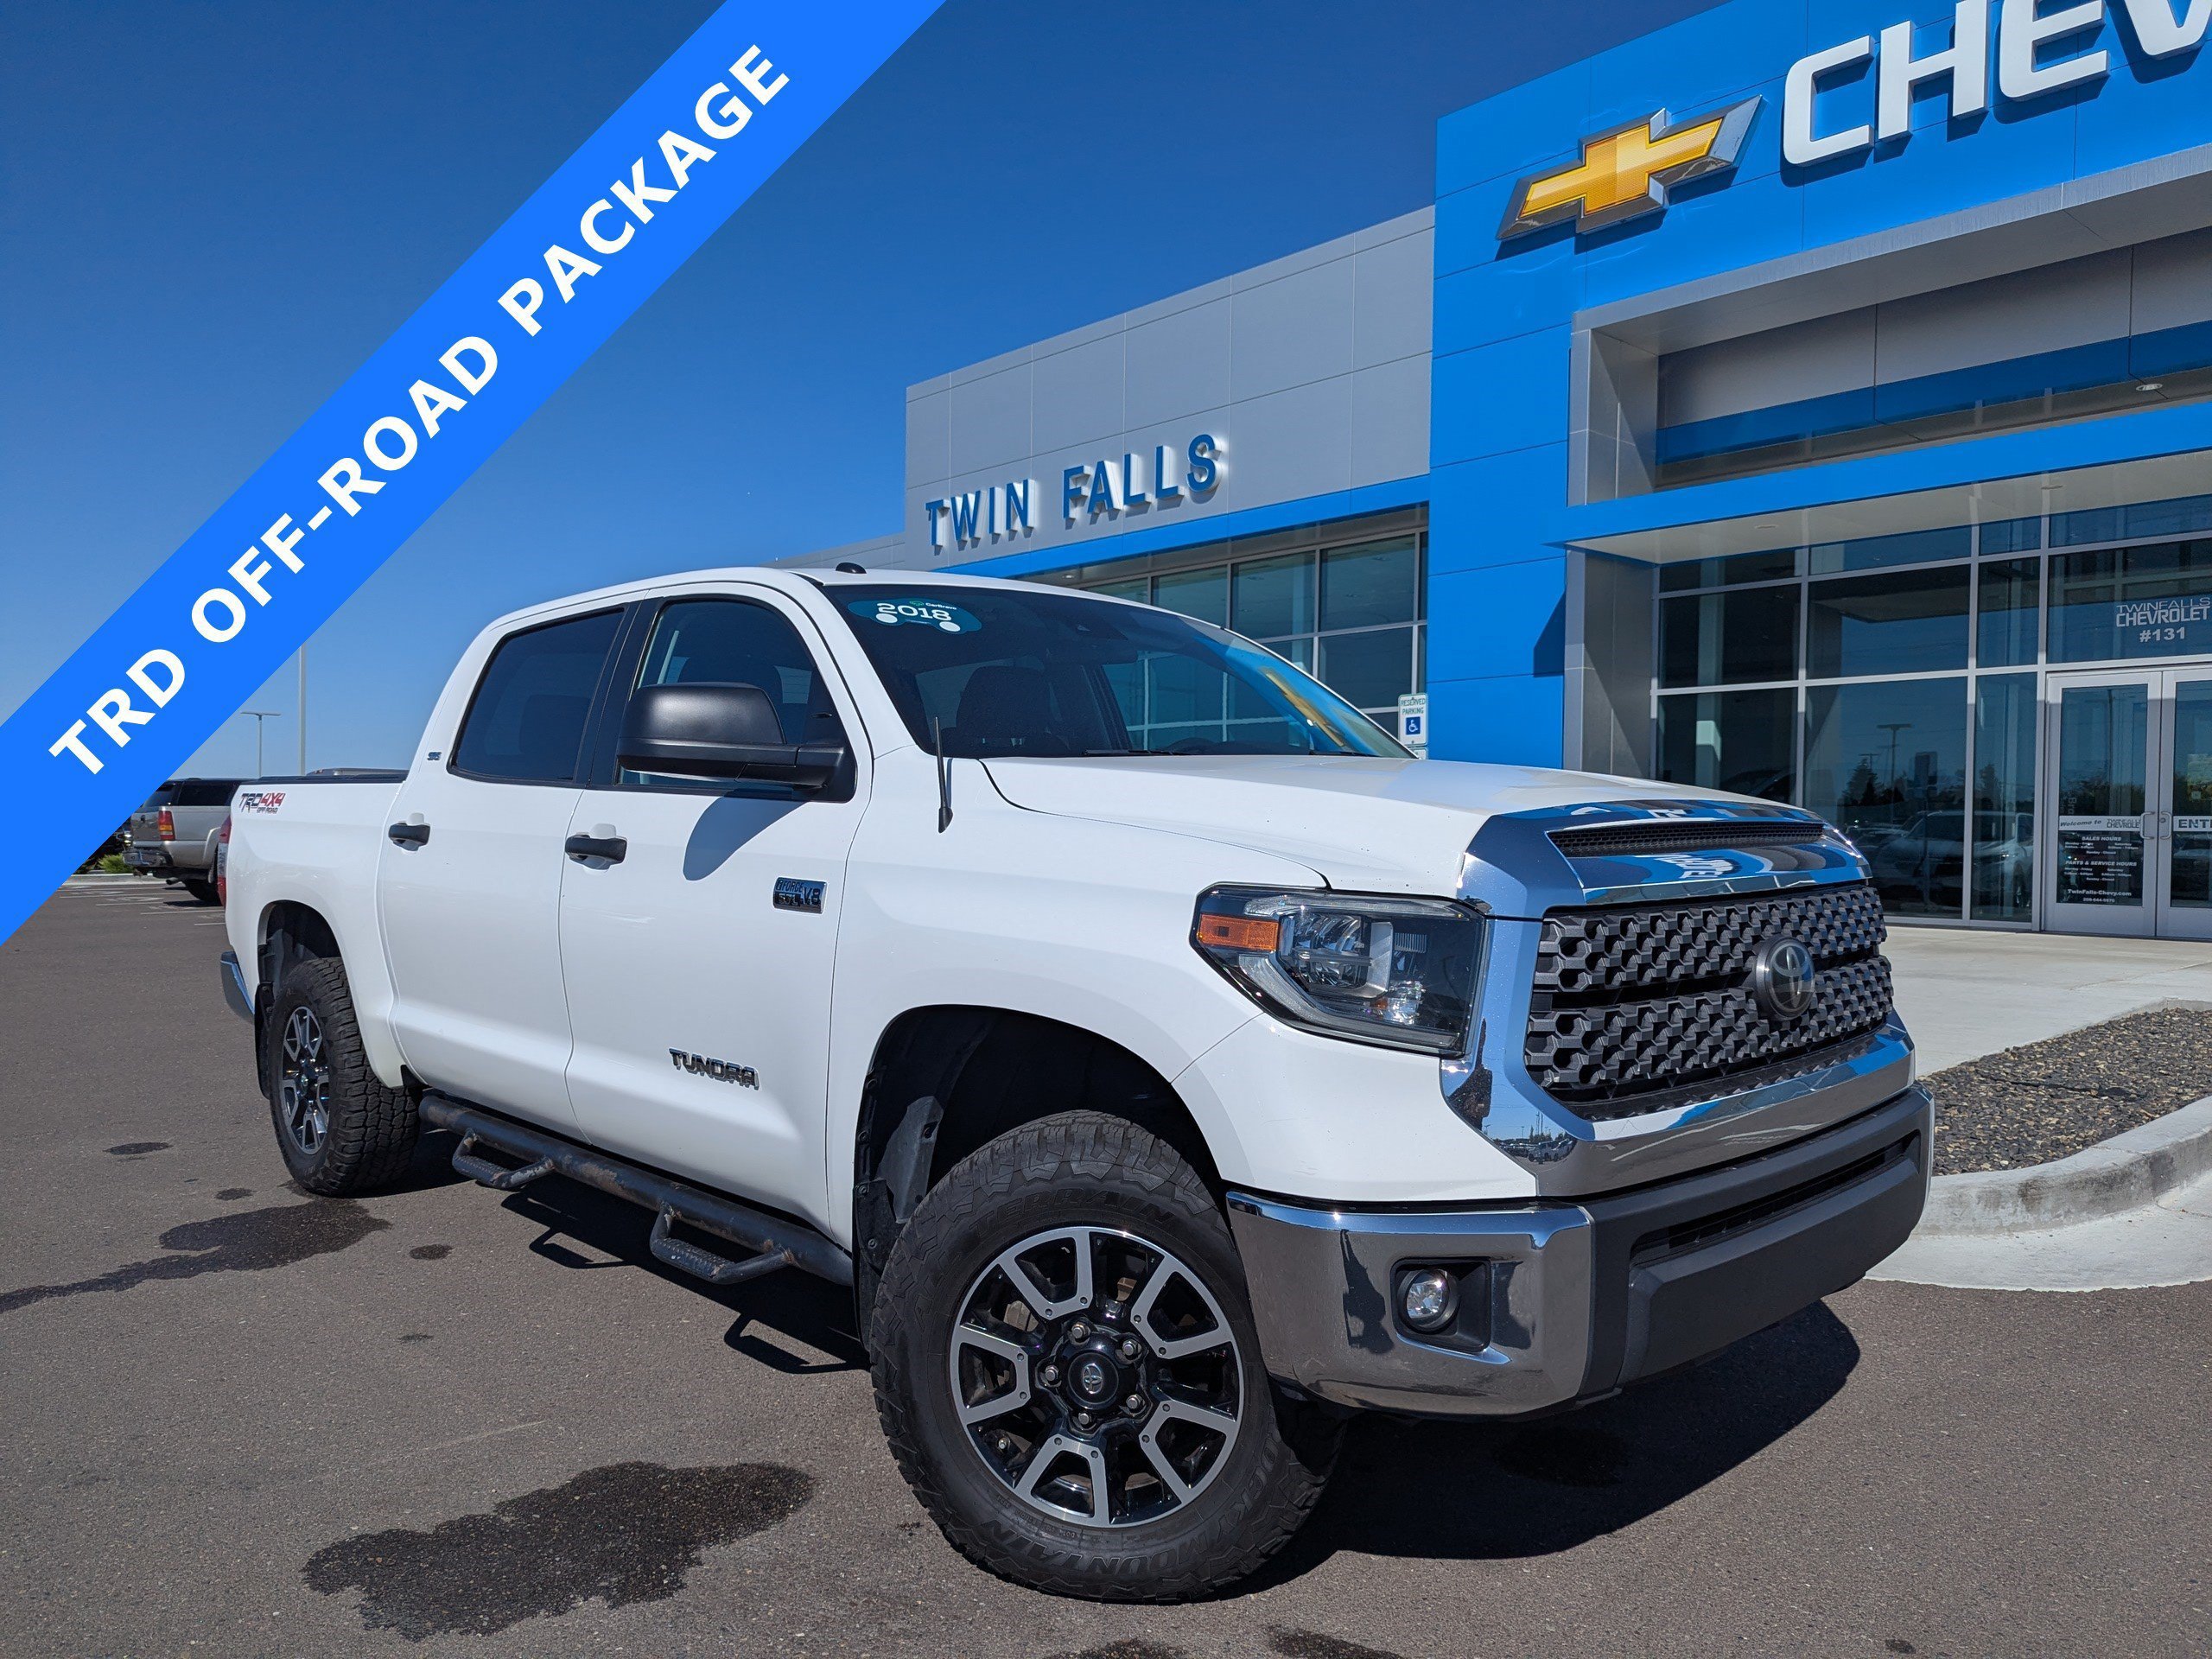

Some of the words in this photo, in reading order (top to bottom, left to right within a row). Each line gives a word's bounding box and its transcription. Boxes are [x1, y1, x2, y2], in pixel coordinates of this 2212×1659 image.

[925, 479, 1035, 547] TWIN
[1063, 434, 1219, 519] FALLS
[876, 602, 952, 620] 2018
[2115, 597, 2210, 613] TWINFALLS
[2115, 606, 2210, 627] CHEVROLET
[2139, 626, 2185, 642] #131
[239, 793, 264, 812] TRD
[2178, 819, 2212, 829] ENT
[804, 887, 821, 906] V8
[669, 1047, 760, 1090] TUNDRA
[969, 1187, 1173, 1231] TERRAIN
[988, 1519, 1210, 1577] MOUNTAIN
